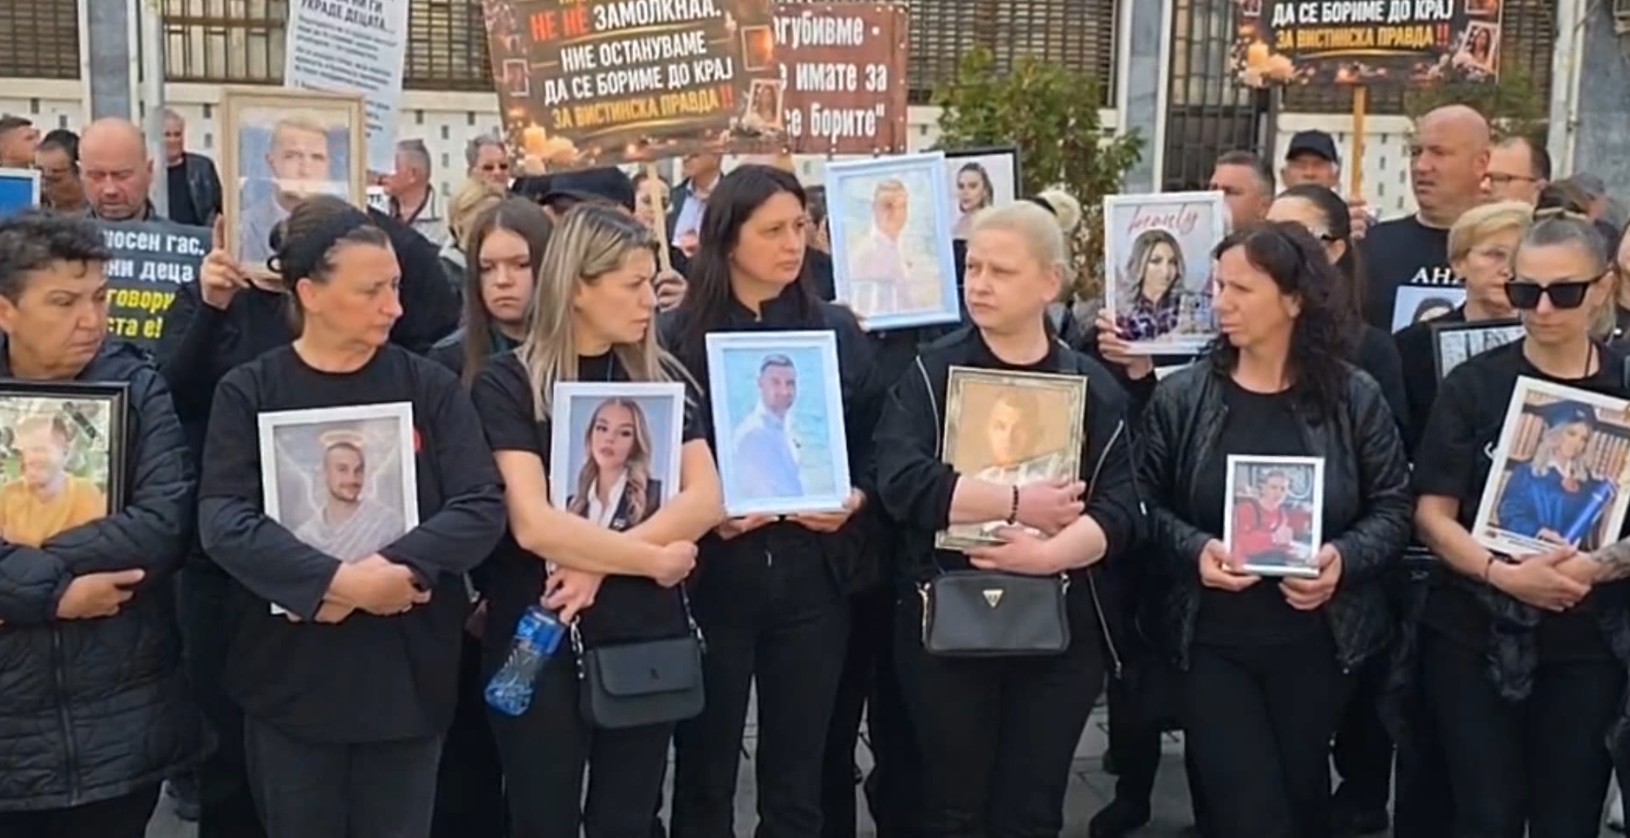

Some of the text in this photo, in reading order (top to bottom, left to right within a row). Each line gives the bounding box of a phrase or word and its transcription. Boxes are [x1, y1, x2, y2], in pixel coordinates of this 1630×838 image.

[530, 0, 722, 42] НЕ НЕ ЗАМОЛКНАА.
[1271, 0, 1454, 27] ДА СЕ БОРИМЕ ДО КРАЈ
[560, 31, 707, 73] НИЕ ОСТАНУВАМЕ
[1276, 30, 1295, 49] ЗА
[1297, 27, 1375, 49] ВИСТИНСКА
[1377, 25, 1434, 48] ПРАВДА
[544, 57, 733, 106] ДА СЕ БОРИМЕ ДО КРАЈ
[796, 63, 857, 91] имате
[865, 64, 887, 92] за
[552, 108, 572, 130] ЗА
[576, 98, 656, 127] ВИСТИНСКА
[660, 89, 719, 116] ПРАВДА
[810, 102, 885, 145] борите"
[166, 235, 206, 255] гас.
[104, 259, 194, 283] ни деца
